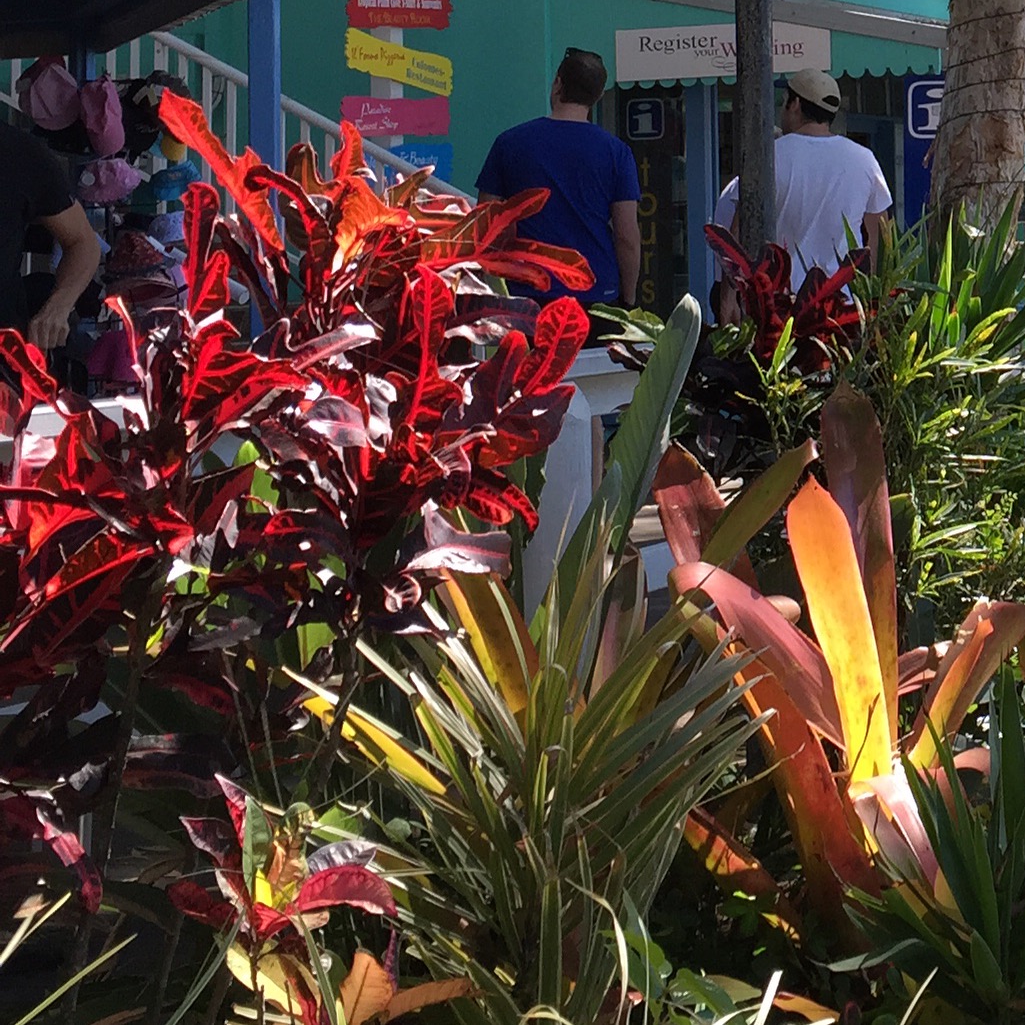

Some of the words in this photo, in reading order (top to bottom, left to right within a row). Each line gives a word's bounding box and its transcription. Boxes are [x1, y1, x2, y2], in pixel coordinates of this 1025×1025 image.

[638, 32, 718, 55] Register
[694, 48, 720, 58] your
[720, 39, 805, 57] Wing
